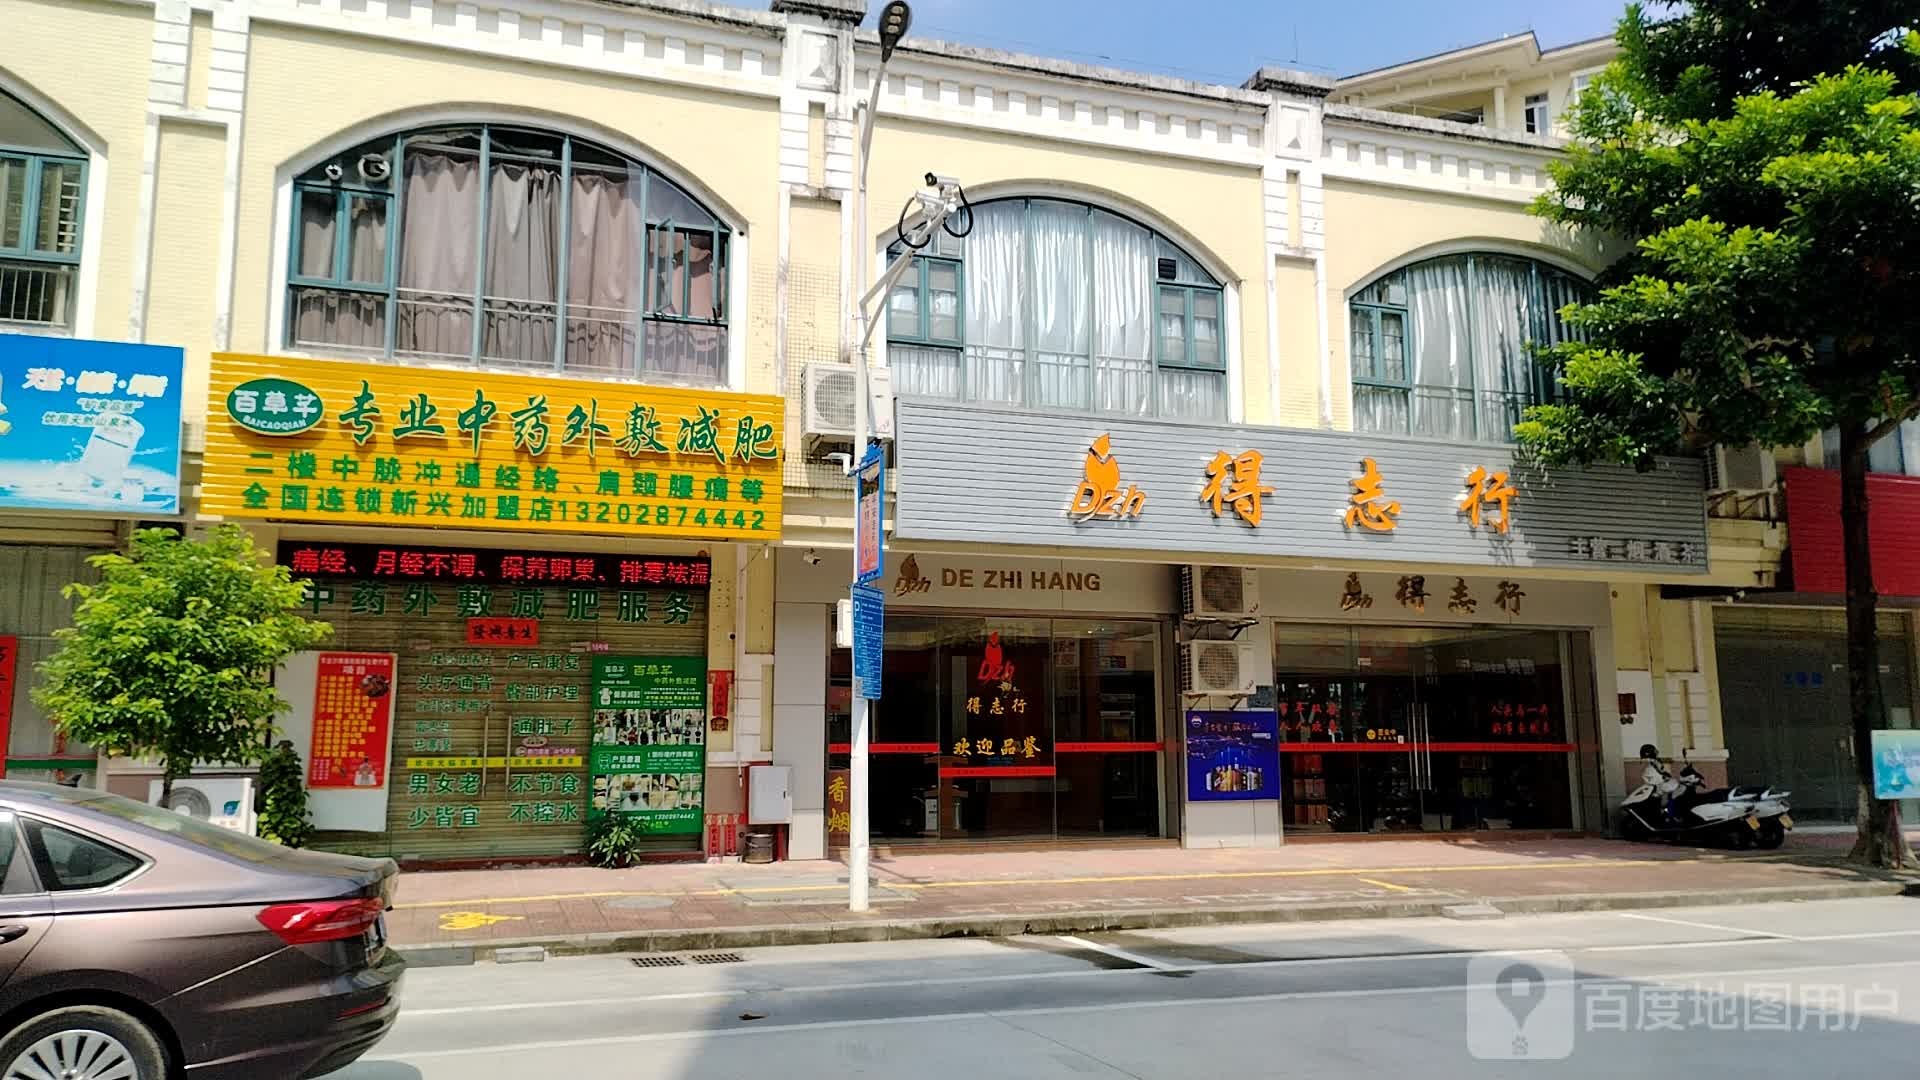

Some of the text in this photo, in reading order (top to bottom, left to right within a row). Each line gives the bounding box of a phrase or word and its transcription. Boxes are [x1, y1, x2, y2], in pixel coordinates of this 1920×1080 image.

[234, 390, 319, 418] 百草芊
[243, 415, 308, 432] BAICAOQIAN
[338, 379, 777, 465] 专业中药外敷减肥
[1200, 449, 1520, 535] 得志行
[942, 567, 974, 588] DE
[984, 569, 1022, 590] ZHI
[1031, 571, 1101, 592] HANG
[301, 579, 696, 626] 中药外敷减肥服务
[1395, 574, 1527, 616] 得志行
[505, 654, 581, 672] 产后康复
[633, 664, 674, 677] 百草芊
[966, 696, 1028, 715] 得志行
[953, 735, 1042, 758] 欢迎品鉴
[409, 772, 482, 796] 男女老
[510, 772, 580, 796] 不节食
[408, 803, 481, 829] 少皆宜
[510, 801, 579, 824] 不控水
[827, 775, 850, 833] 香烟
